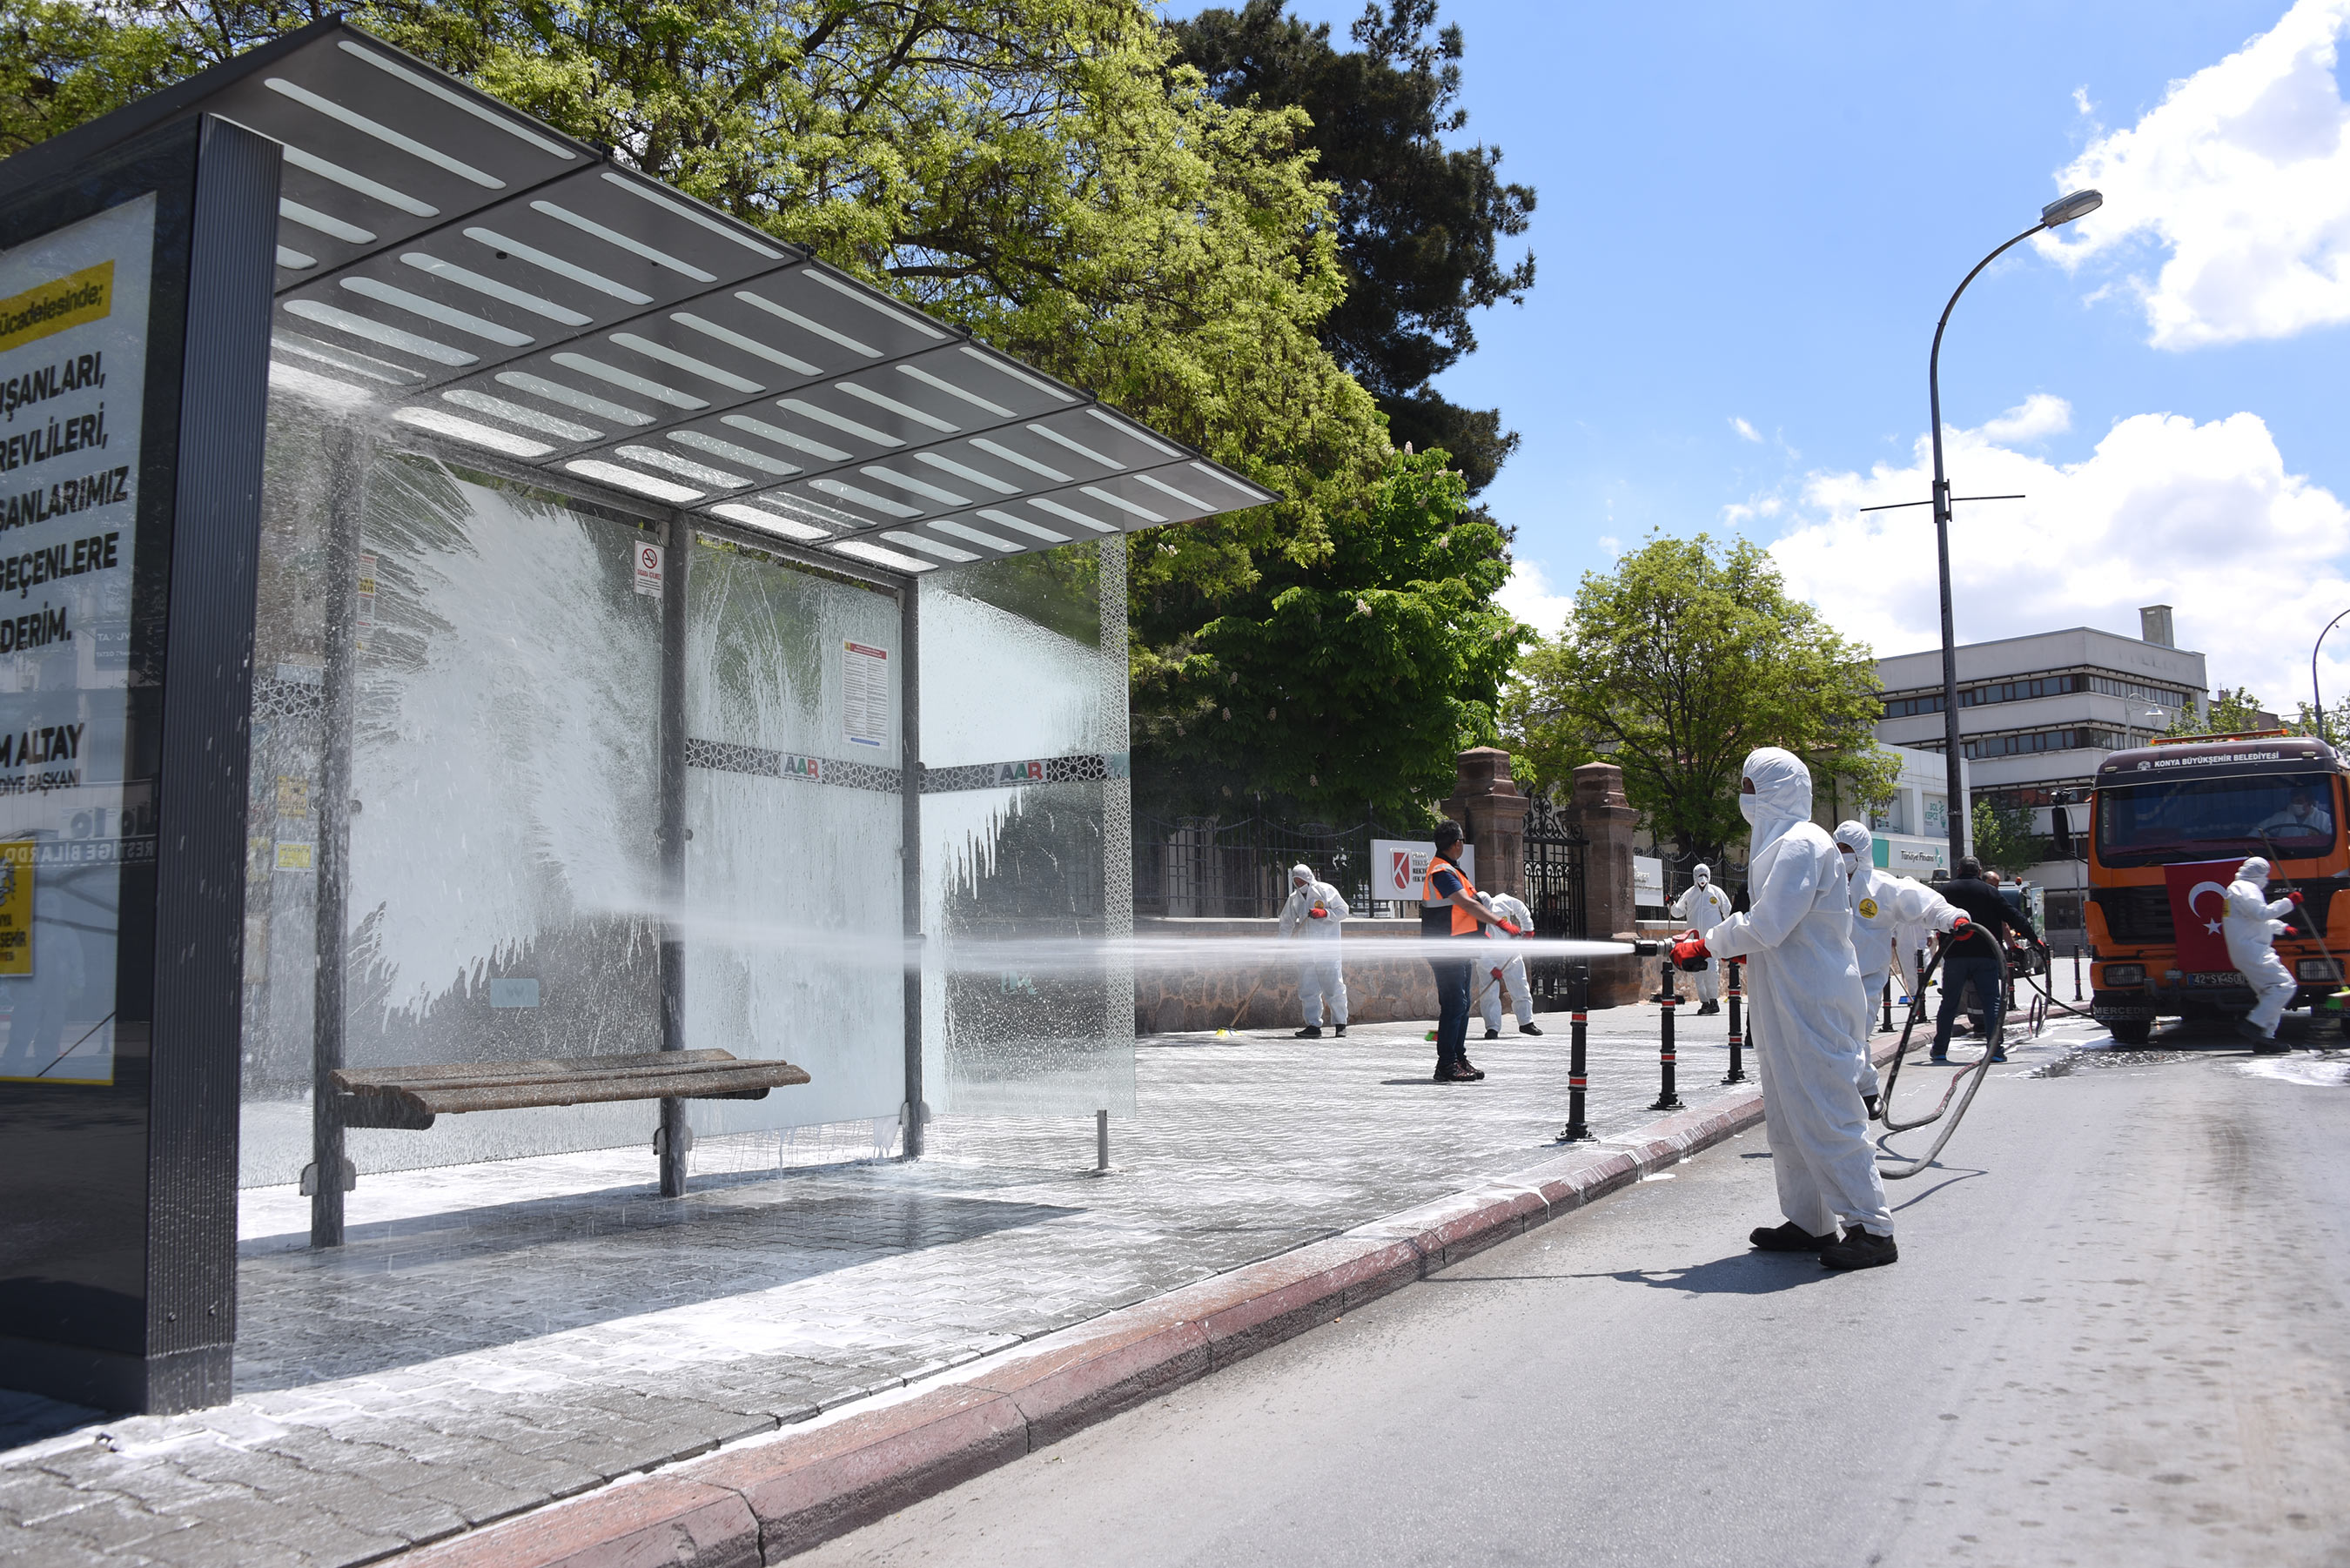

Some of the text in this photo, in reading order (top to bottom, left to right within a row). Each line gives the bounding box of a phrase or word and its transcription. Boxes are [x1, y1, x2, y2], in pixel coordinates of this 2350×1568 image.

[0, 601, 72, 653] DERİM.
[15, 723, 84, 767] ALTAY
[2182, 754, 2232, 765] BÜYÜKŞEHİR
[2233, 751, 2280, 761] BELEDİYESİ
[28, 768, 81, 797] BAŞKANI
[1901, 849, 1934, 862] Türkiye Finans
[2094, 1006, 2153, 1015] MERCEDE
